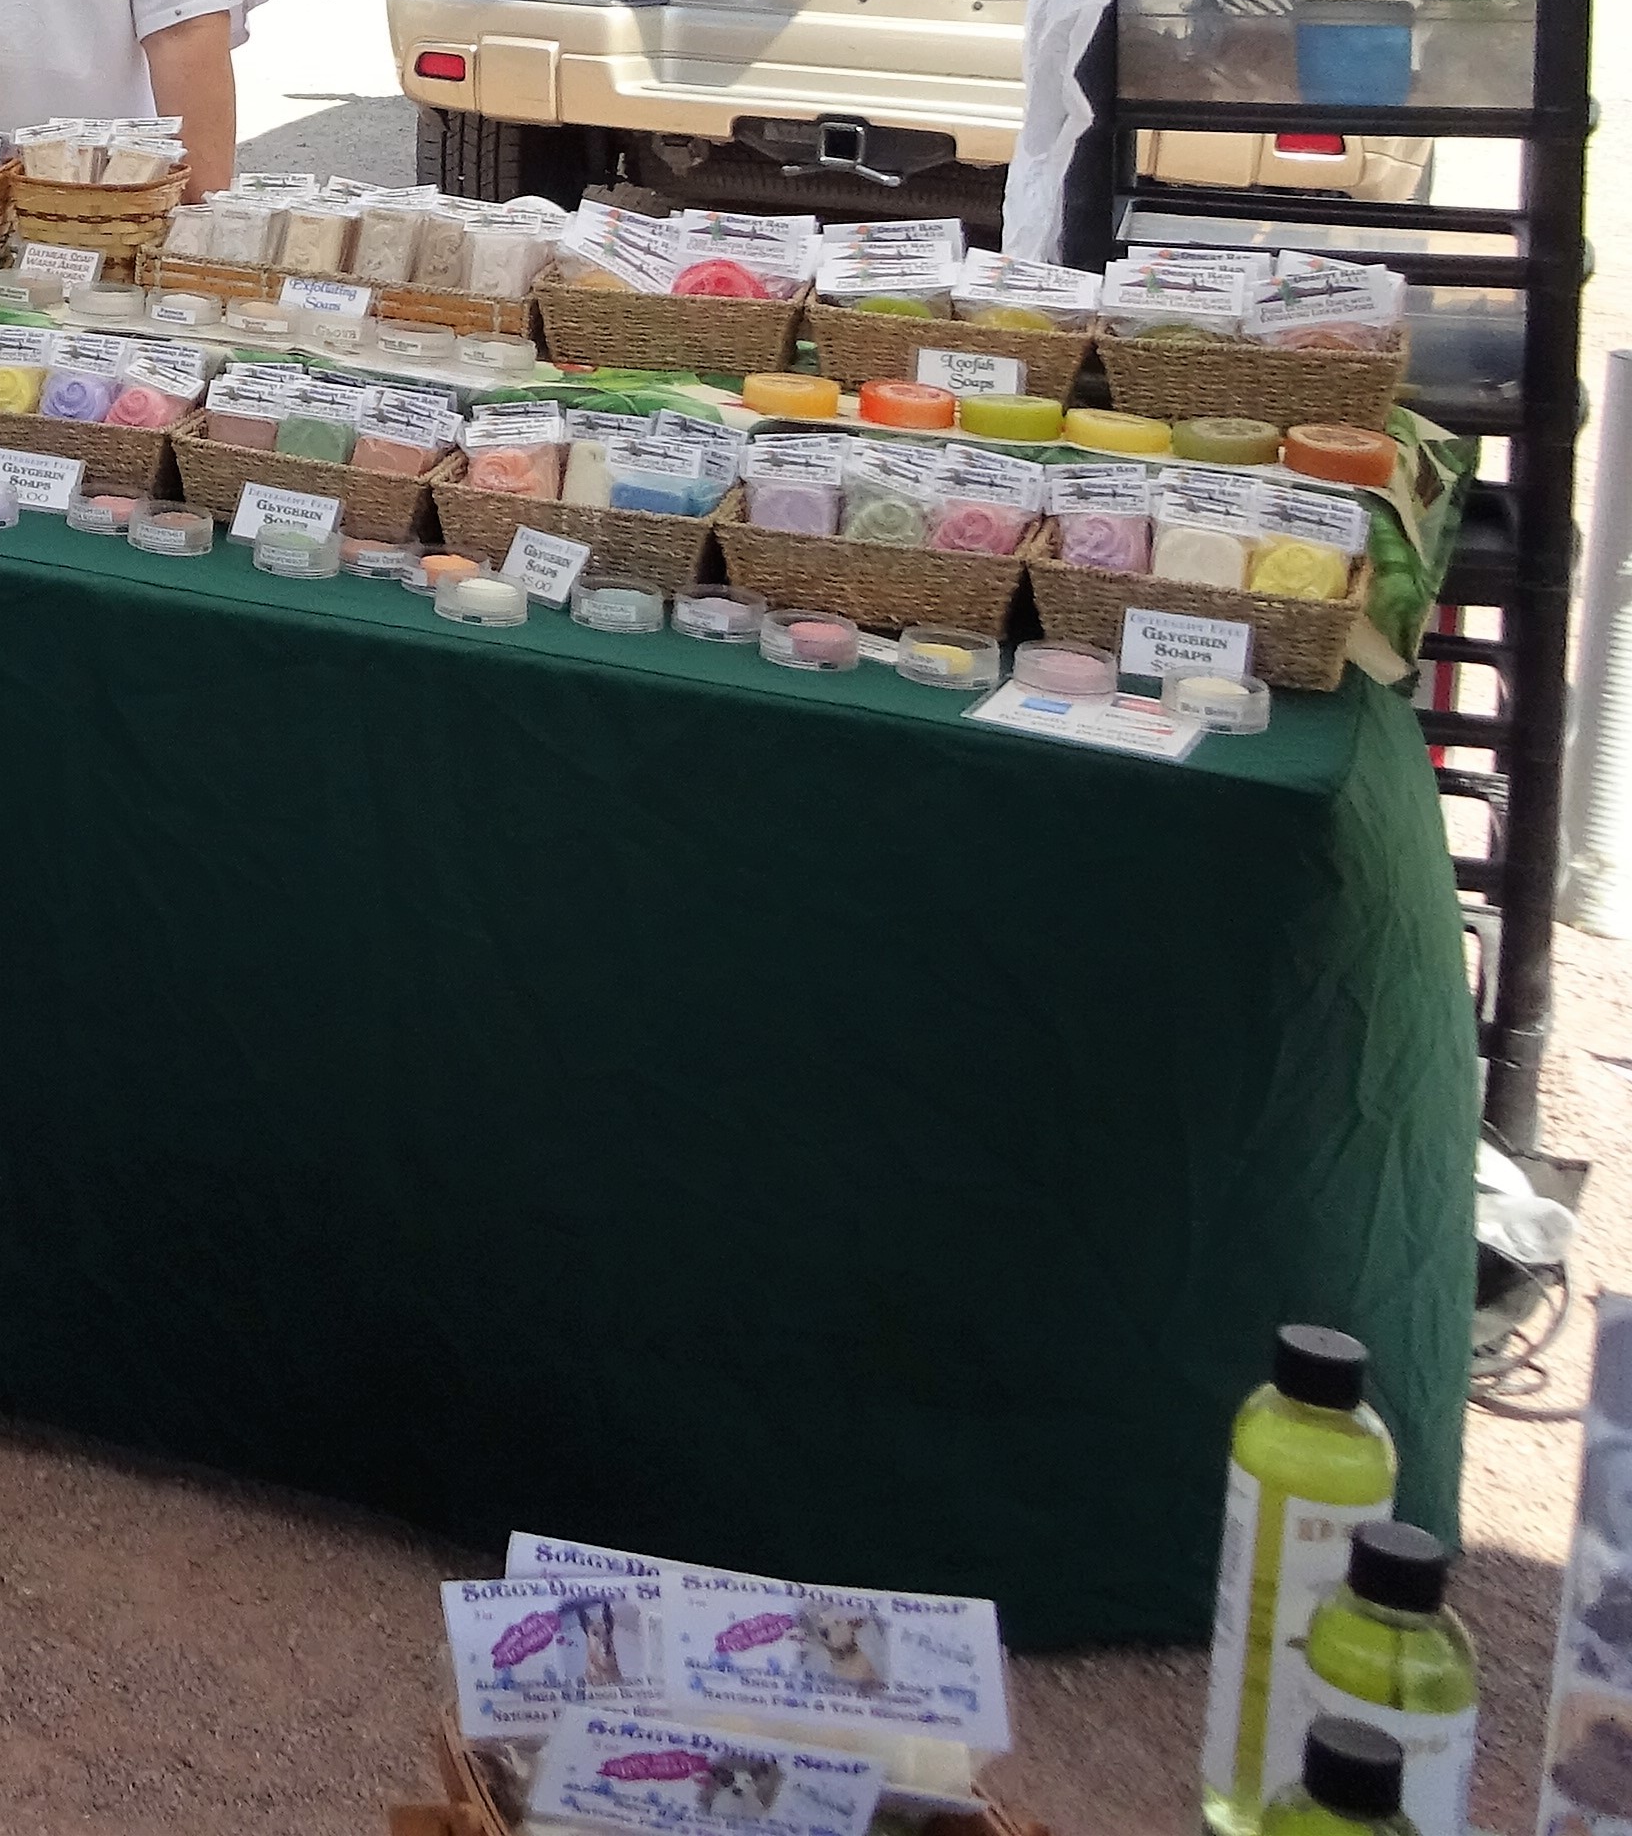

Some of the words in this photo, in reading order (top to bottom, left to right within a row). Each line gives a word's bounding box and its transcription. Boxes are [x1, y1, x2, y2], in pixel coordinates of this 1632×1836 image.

[288, 277, 359, 301] Exfoliating
[940, 352, 995, 375] Loofah
[947, 372, 995, 393] Soaps
[2, 461, 66, 482] GLYCERIN
[9, 474, 52, 491] SOAPS
[256, 498, 324, 522] GLYCERIN
[525, 561, 560, 580] SOAPS
[1141, 625, 1228, 650] GLYCERIN
[1154, 642, 1213, 664] SOAPS
[461, 1581, 548, 1604] SOGGY
[549, 1580, 628, 1601] DOGGY
